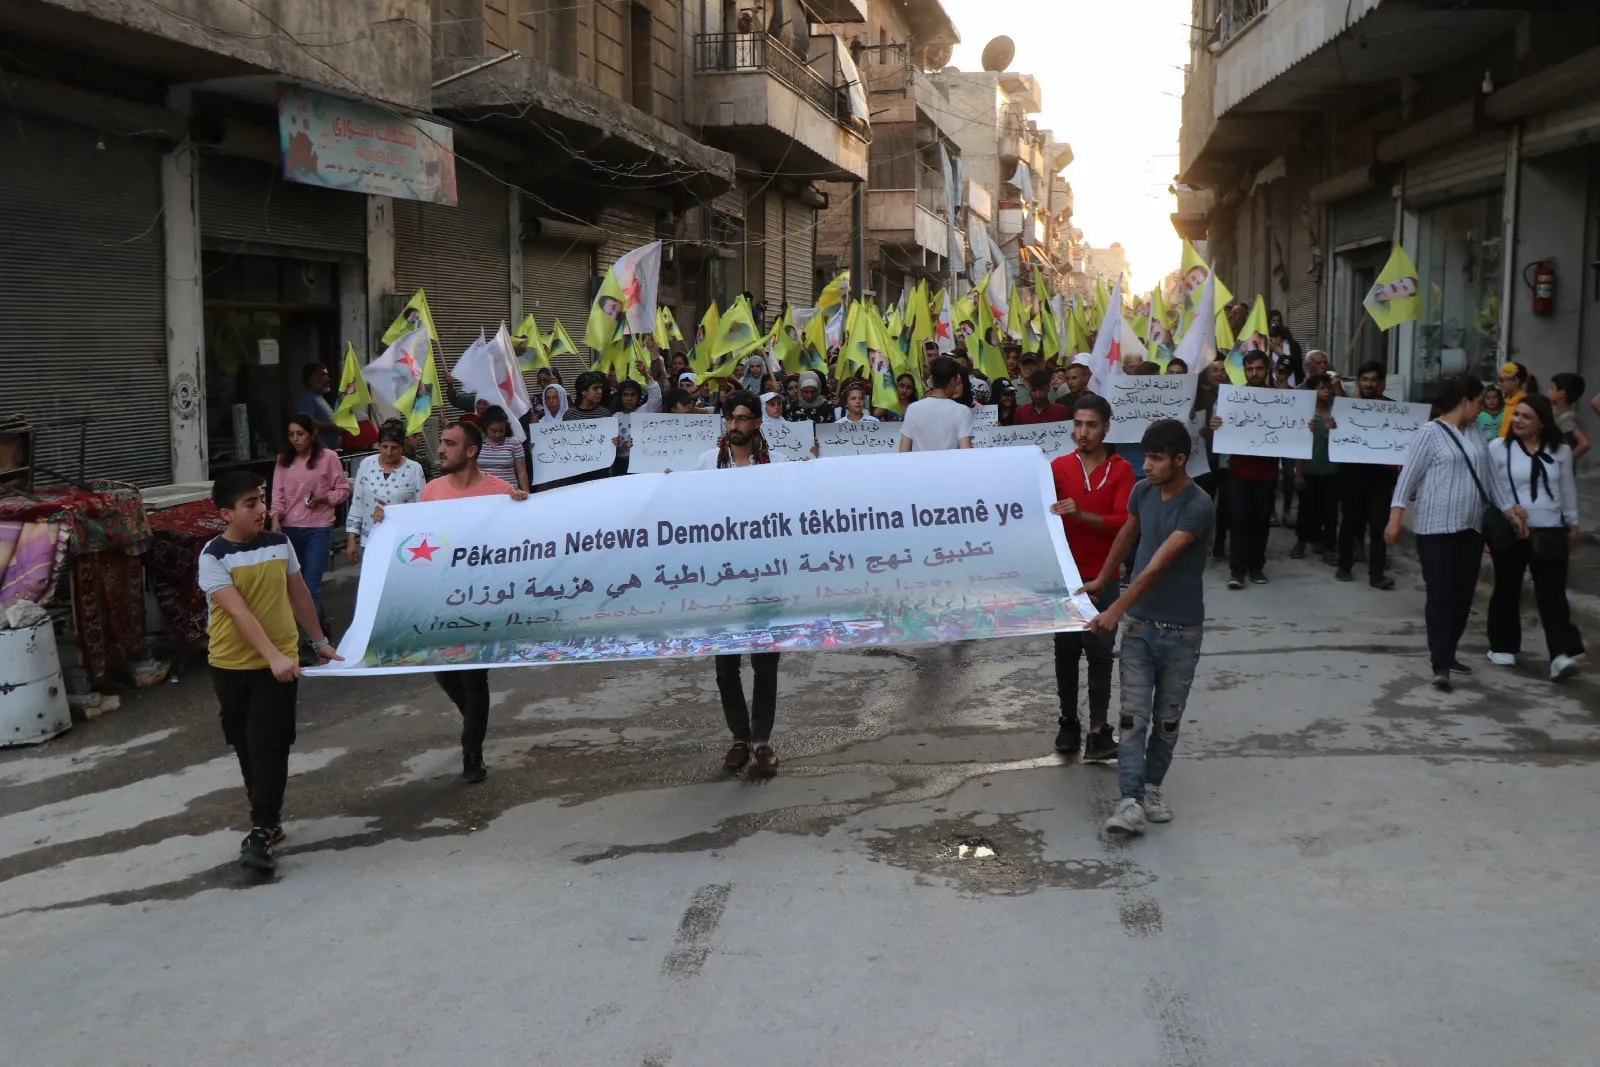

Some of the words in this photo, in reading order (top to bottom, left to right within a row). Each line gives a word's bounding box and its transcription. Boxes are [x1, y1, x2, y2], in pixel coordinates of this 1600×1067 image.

[451, 539, 556, 567] Pêkanîna
[565, 528, 649, 555] Netewa
[657, 512, 793, 546] Demokratîk
[799, 507, 904, 535] têkbirina
[911, 499, 989, 527] lozanê
[995, 502, 1024, 526] ye
[799, 551, 855, 572] الأمة
[866, 548, 912, 574] نهج
[923, 540, 994, 567] تطبيق
[606, 573, 642, 598] هي
[654, 557, 788, 590] الديمقراطية
[445, 581, 515, 606] لوزان
[524, 576, 594, 601] هزيمة
